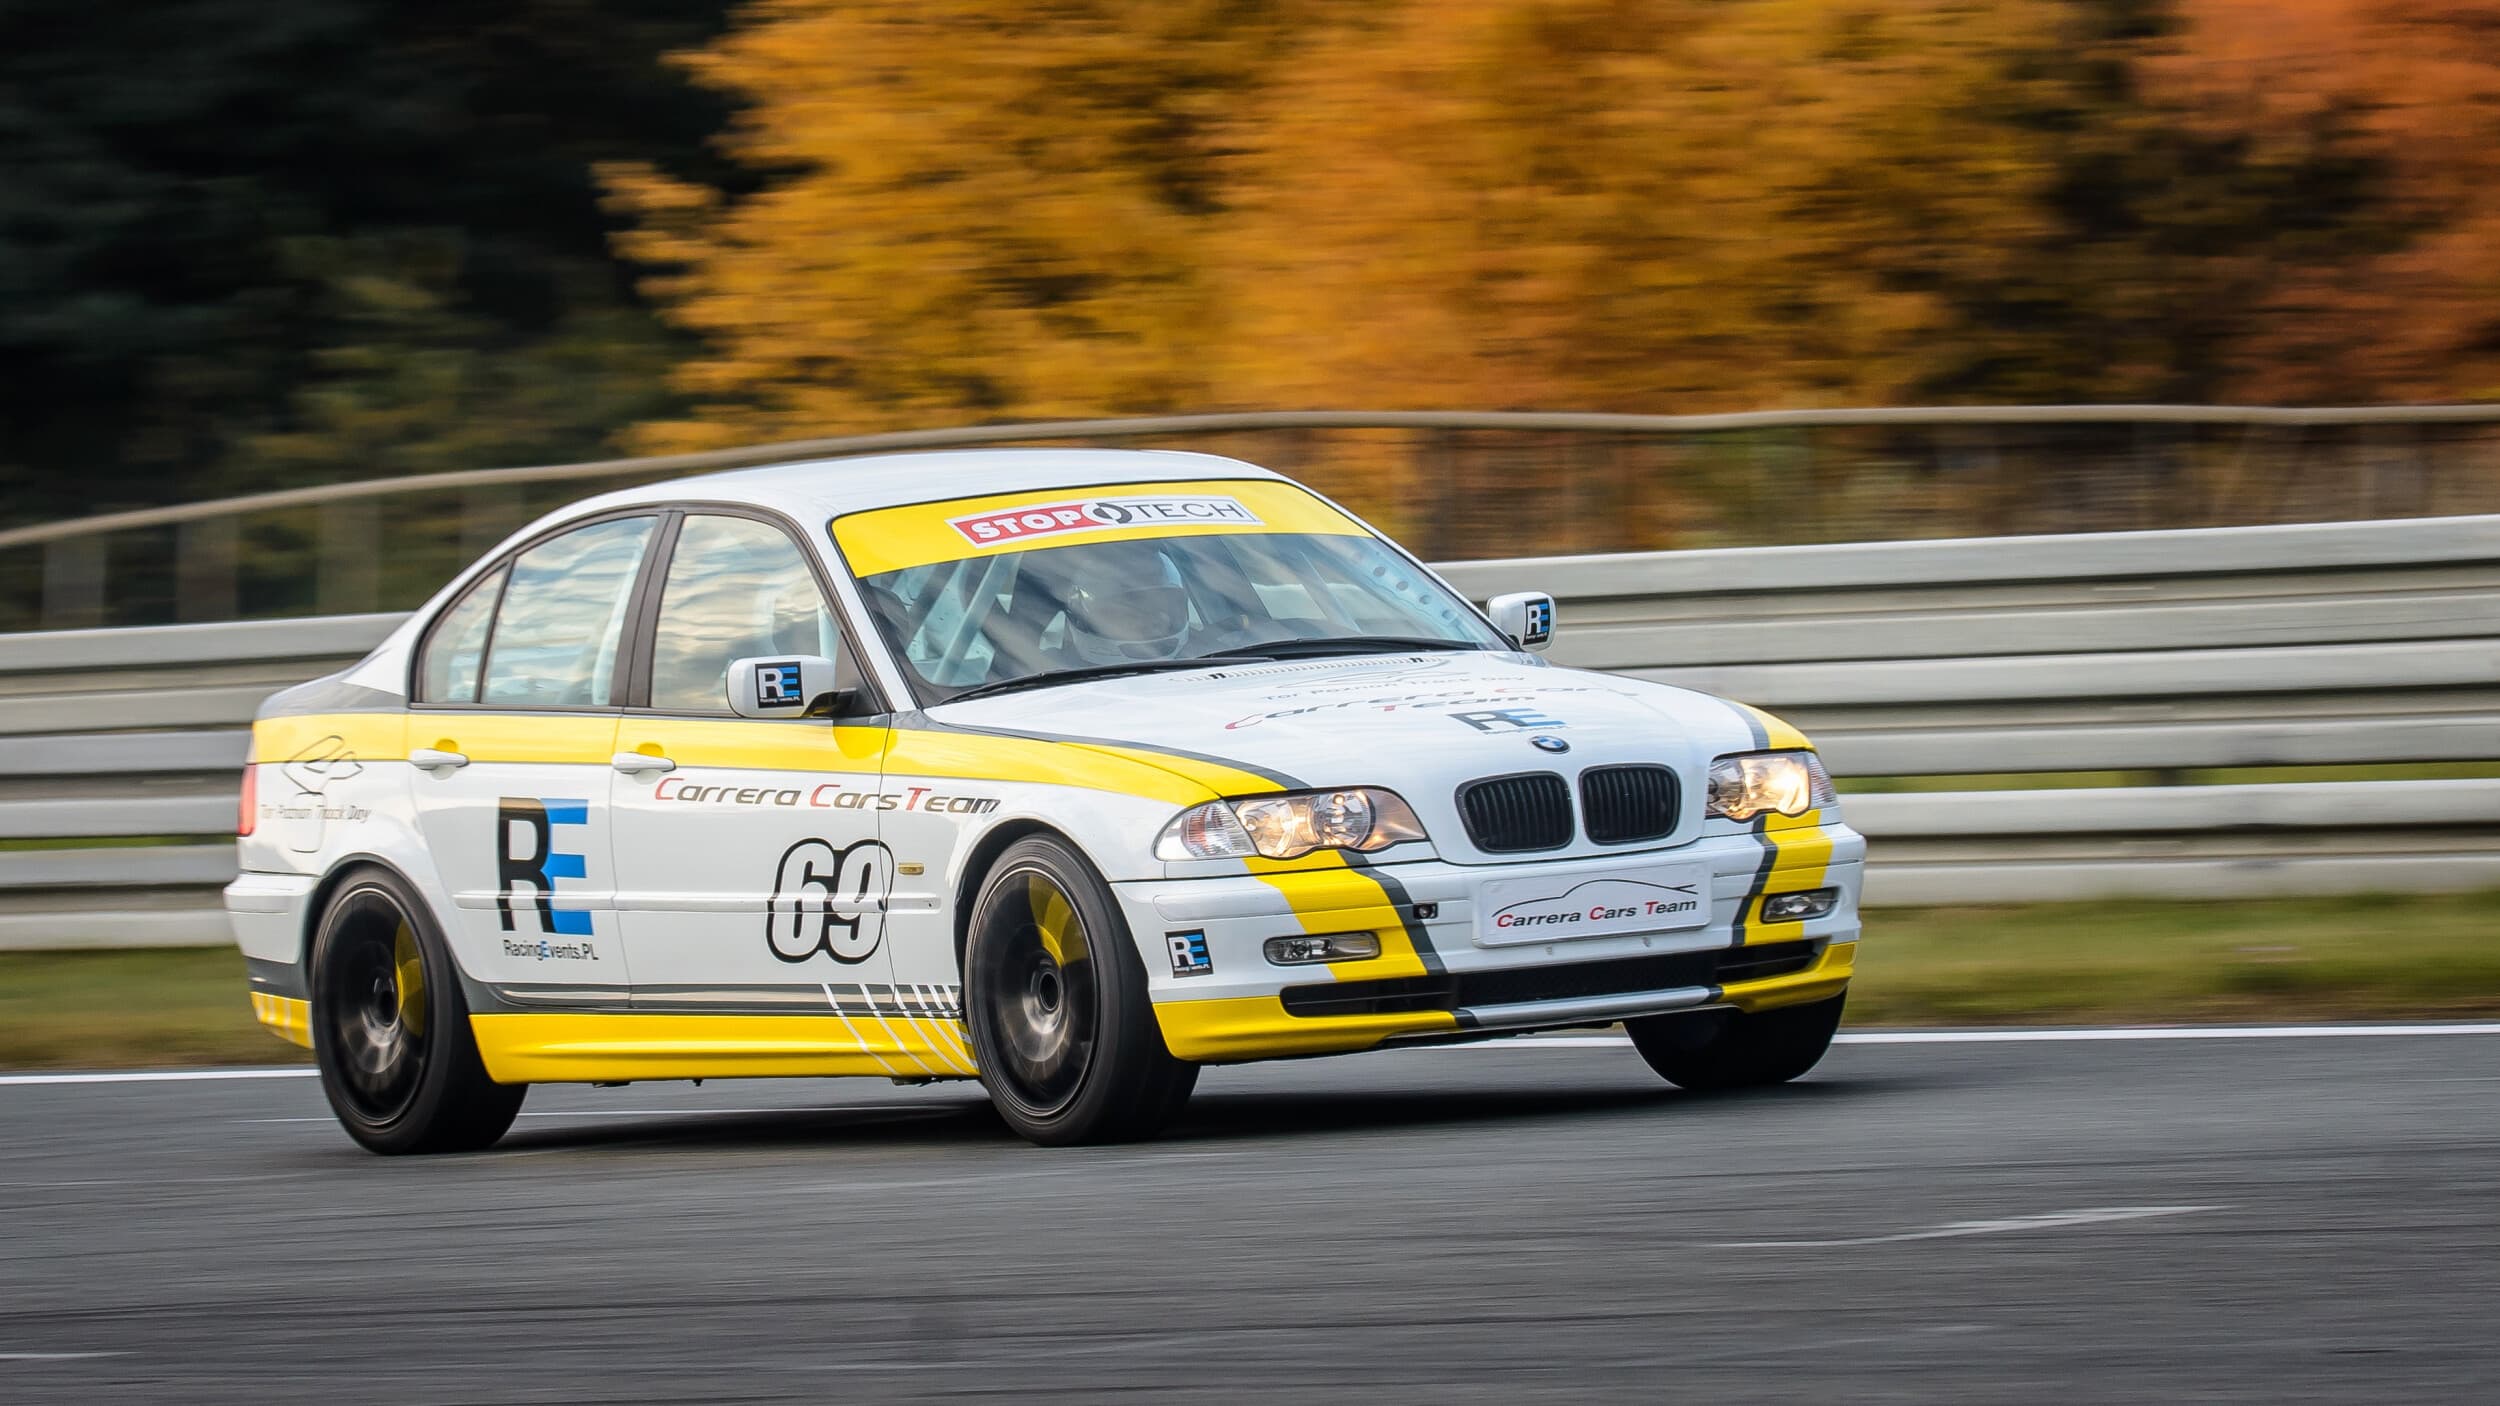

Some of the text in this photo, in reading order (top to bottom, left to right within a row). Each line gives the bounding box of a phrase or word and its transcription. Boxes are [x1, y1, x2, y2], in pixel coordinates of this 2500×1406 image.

[970, 503, 1245, 540] STOP TECH
[758, 667, 800, 698] RE
[654, 777, 1001, 815] Carrera Cars Team
[497, 797, 594, 936] RE
[766, 837, 895, 965] 69
[1496, 900, 1697, 928] Carrera Cars Team
[503, 939, 600, 961] RacingEvents.PL
[1168, 934, 1209, 967] RE
